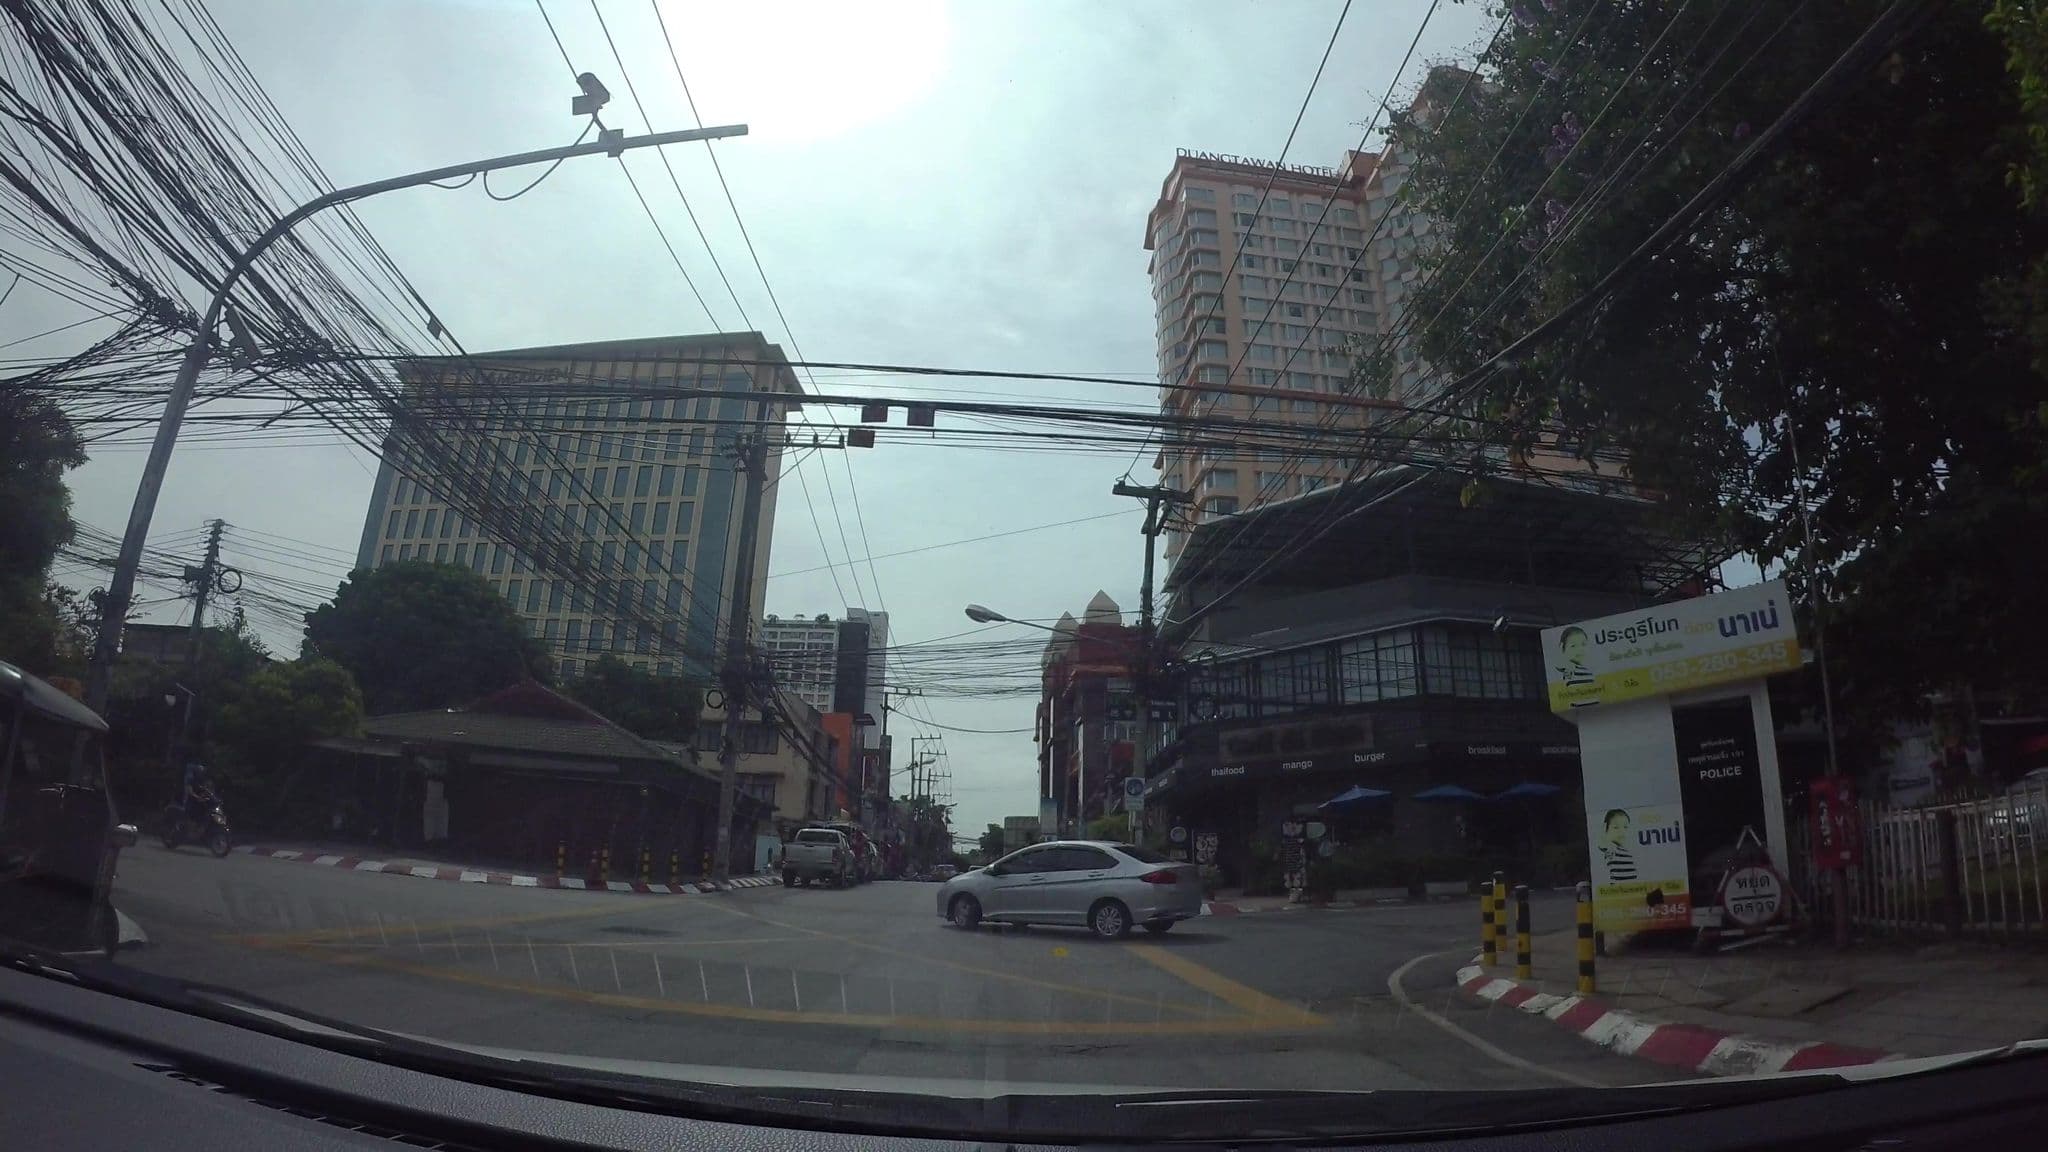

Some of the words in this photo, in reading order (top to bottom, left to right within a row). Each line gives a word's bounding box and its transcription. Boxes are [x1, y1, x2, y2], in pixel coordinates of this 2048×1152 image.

[1176, 147, 1286, 171] DUANGTAWAN
[1291, 163, 1338, 178] HOTEL
[1354, 751, 1386, 763] burger
[1282, 759, 1313, 770] mango
[1211, 765, 1245, 777] thaifood
[1700, 766, 1742, 780] POLICE
